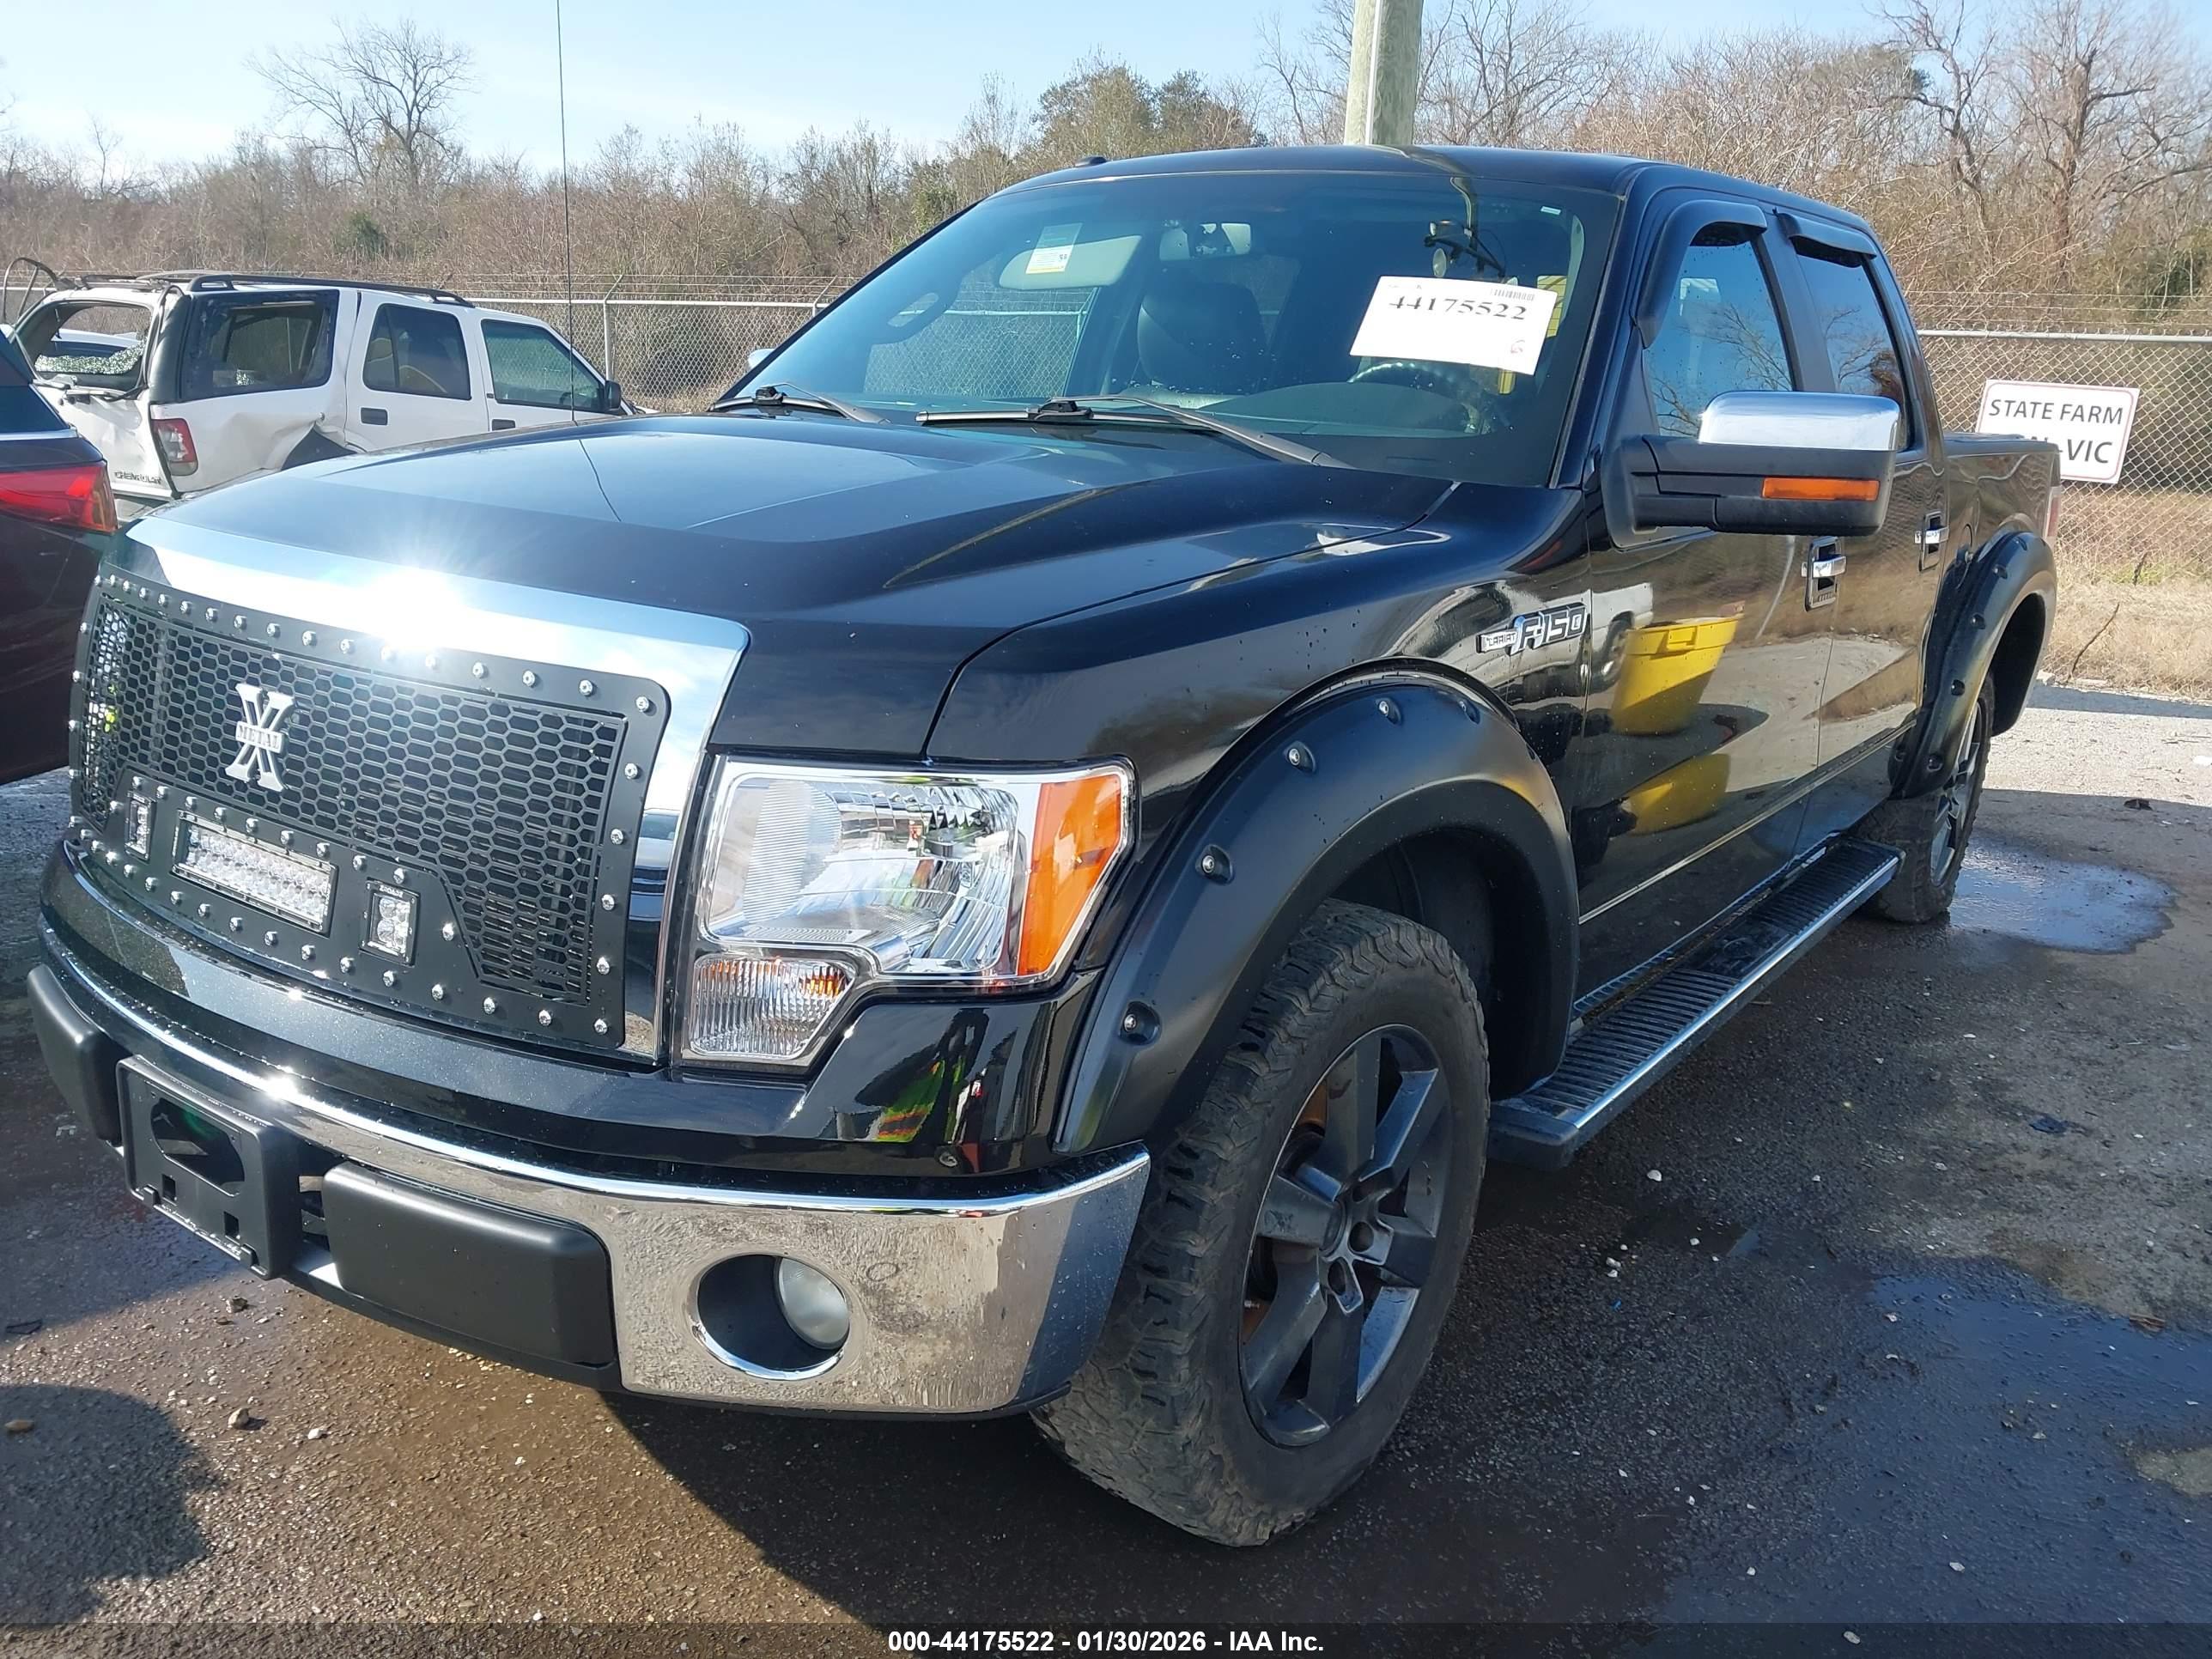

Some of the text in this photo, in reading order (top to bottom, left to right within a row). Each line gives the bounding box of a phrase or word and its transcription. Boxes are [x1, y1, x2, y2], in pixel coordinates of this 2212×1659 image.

[1389, 296, 1527, 320] 44175522
[1989, 399, 2124, 425] STATE FARM
